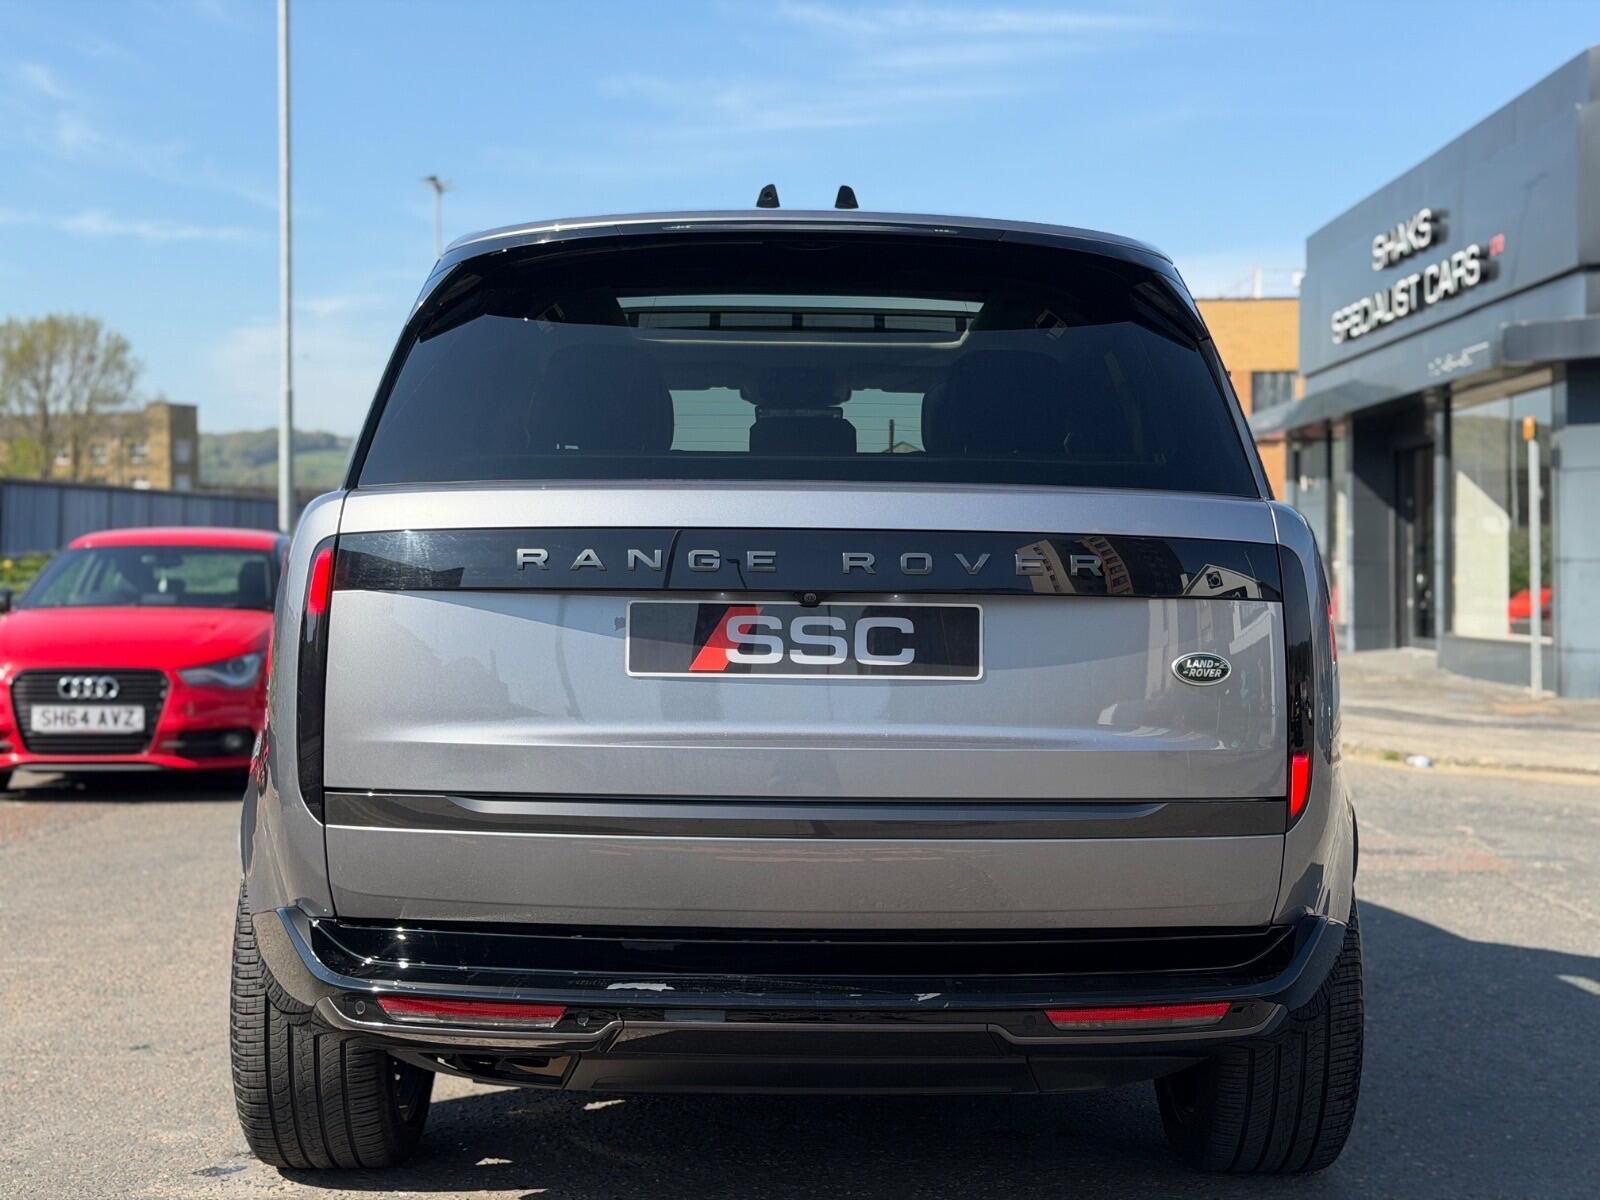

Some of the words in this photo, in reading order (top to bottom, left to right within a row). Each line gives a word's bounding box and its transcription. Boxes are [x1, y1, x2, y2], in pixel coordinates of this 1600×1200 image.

[1371, 207, 1433, 272] SHAKS
[1331, 273, 1421, 345] SPECIALIST
[1423, 243, 1481, 305] CARS
[515, 547, 777, 572] RANGE
[841, 551, 1104, 576] ROVER
[725, 615, 916, 666] SSC
[1186, 659, 1214, 668] LAND
[1188, 668, 1222, 678] ROVER
[40, 709, 90, 727] SH64
[96, 709, 136, 727] AVZ
